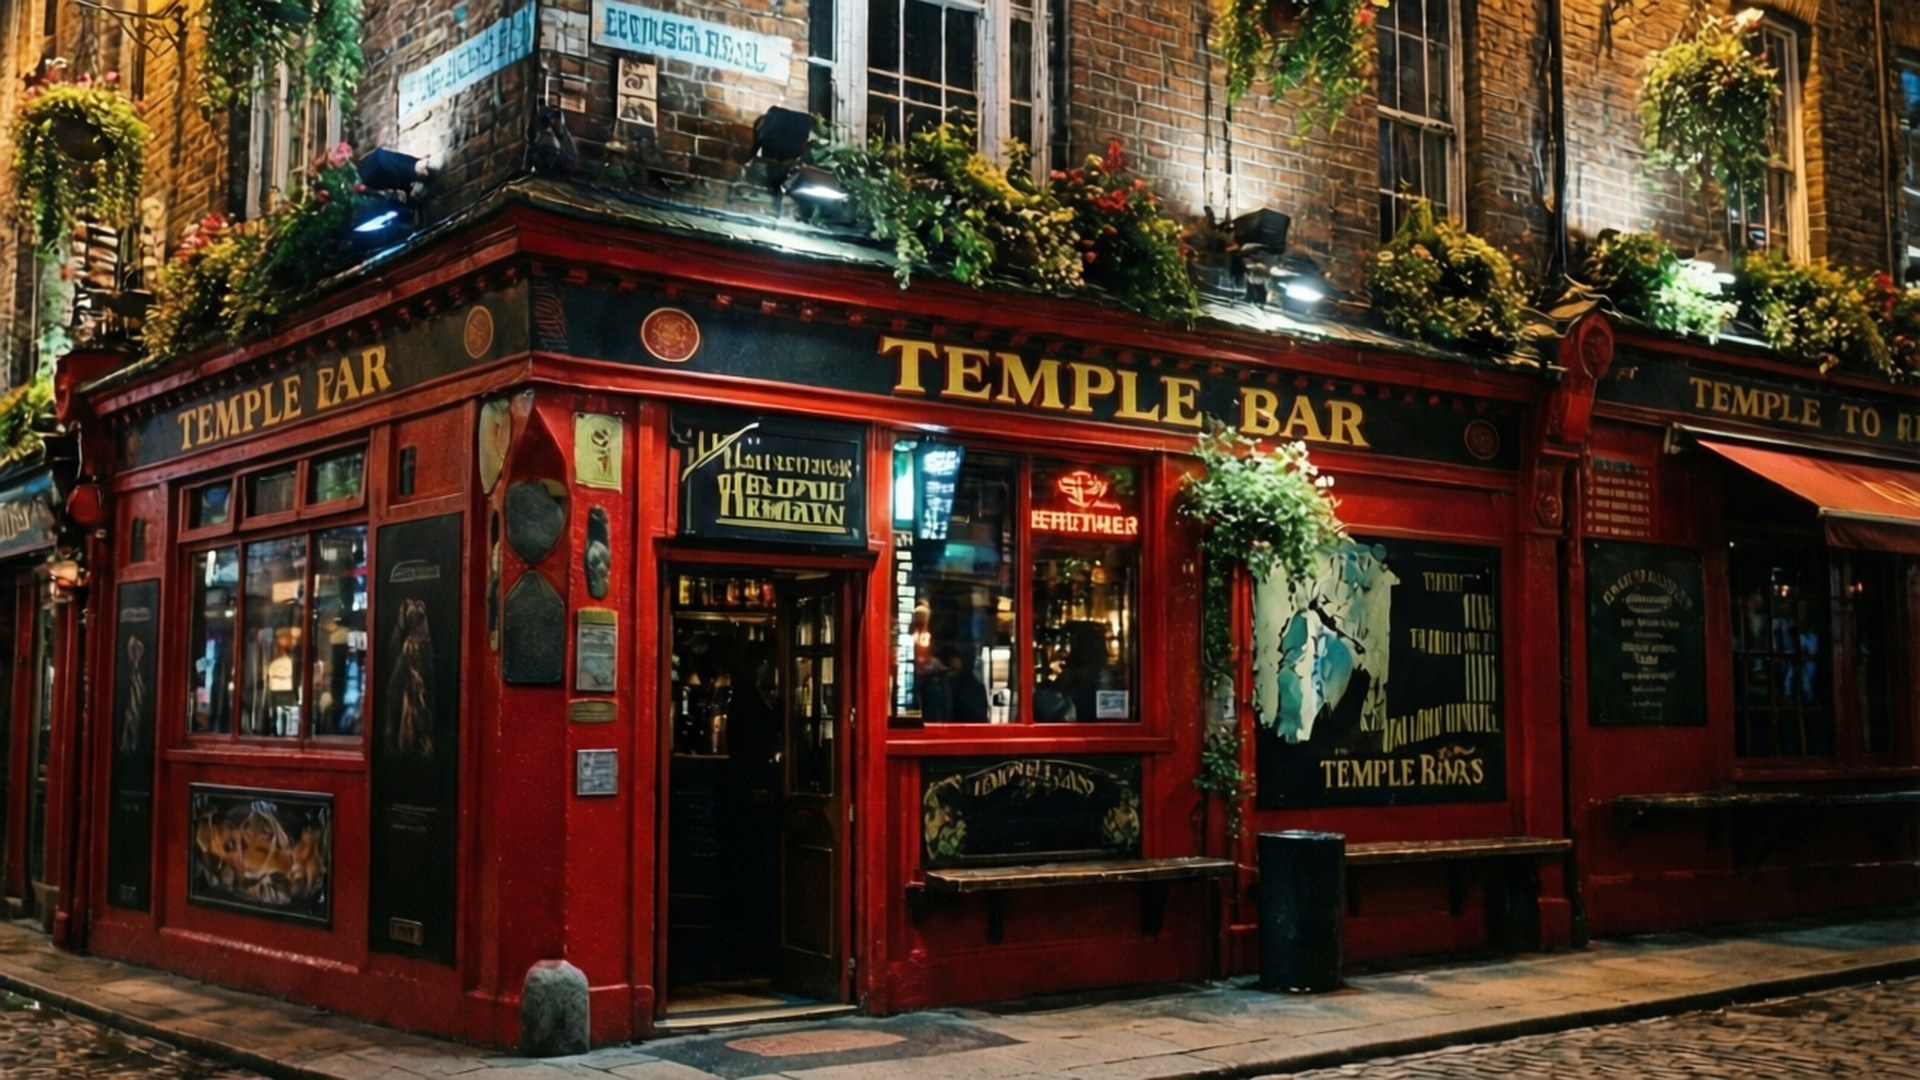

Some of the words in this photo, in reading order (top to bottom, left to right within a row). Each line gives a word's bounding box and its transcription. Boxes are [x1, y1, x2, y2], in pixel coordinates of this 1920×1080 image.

[177, 374, 302, 450] TEMPLE
[880, 336, 1202, 428] TEMPLE
[1238, 386, 1371, 449] BAR
[1689, 376, 1822, 428] TEMPLE
[1840, 403, 1882, 438] TO
[1320, 759, 1416, 788] TEMPLE
